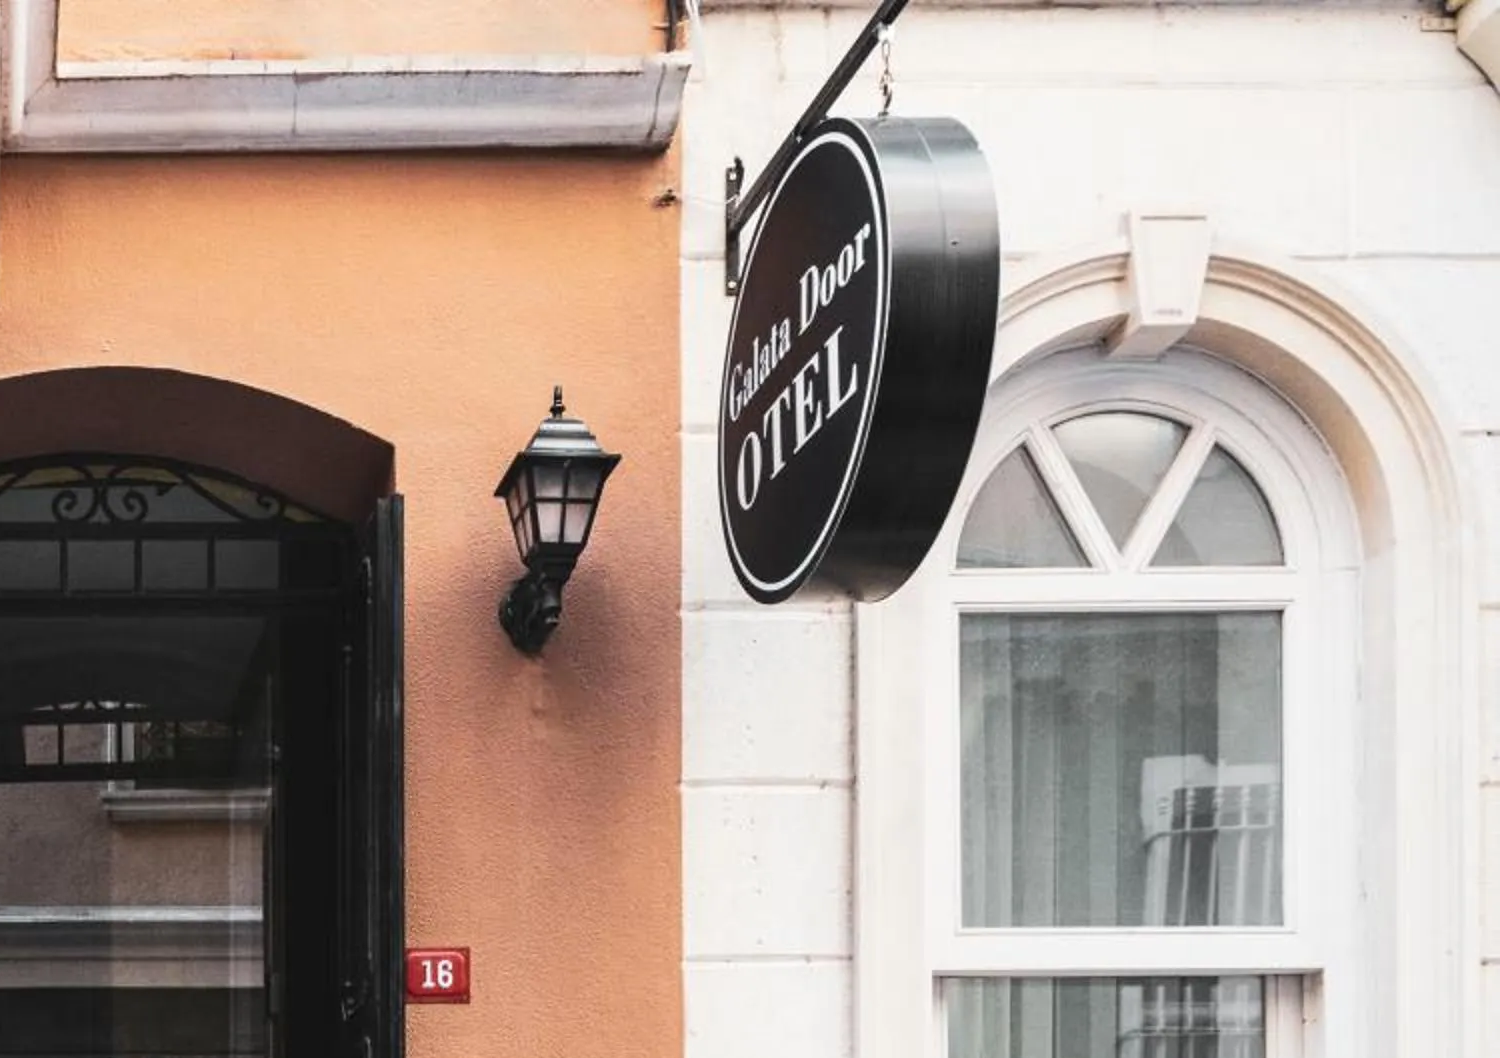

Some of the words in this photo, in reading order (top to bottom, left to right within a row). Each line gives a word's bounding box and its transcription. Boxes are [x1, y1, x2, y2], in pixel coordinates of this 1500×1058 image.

[729, 317, 791, 422] Galata
[799, 222, 871, 336] Door
[736, 325, 858, 512] OTEL
[421, 959, 453, 989] 16
